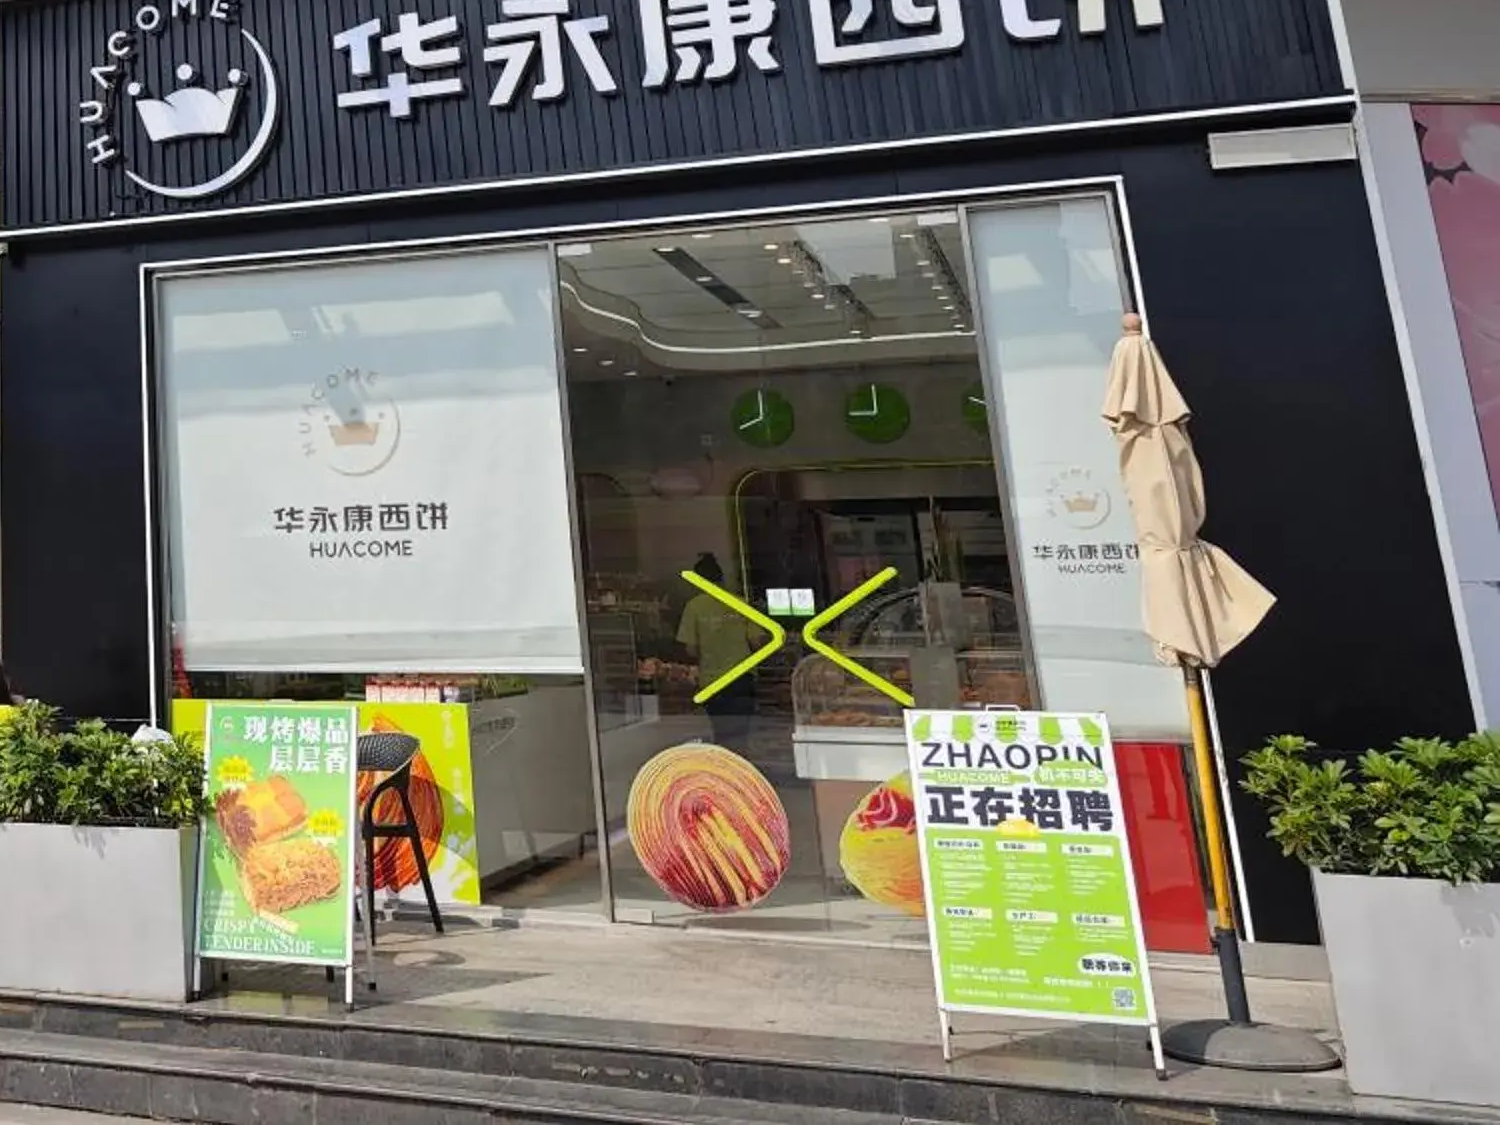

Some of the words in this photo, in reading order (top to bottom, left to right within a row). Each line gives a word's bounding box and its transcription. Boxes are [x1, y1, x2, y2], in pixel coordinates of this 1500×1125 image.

[274, 502, 448, 534] 华永康西饼
[310, 540, 413, 559] HUACOME
[270, 745, 349, 774] 层层香
[921, 742, 1105, 771] ZHAOPIN
[925, 785, 1114, 832] 正在招聘
